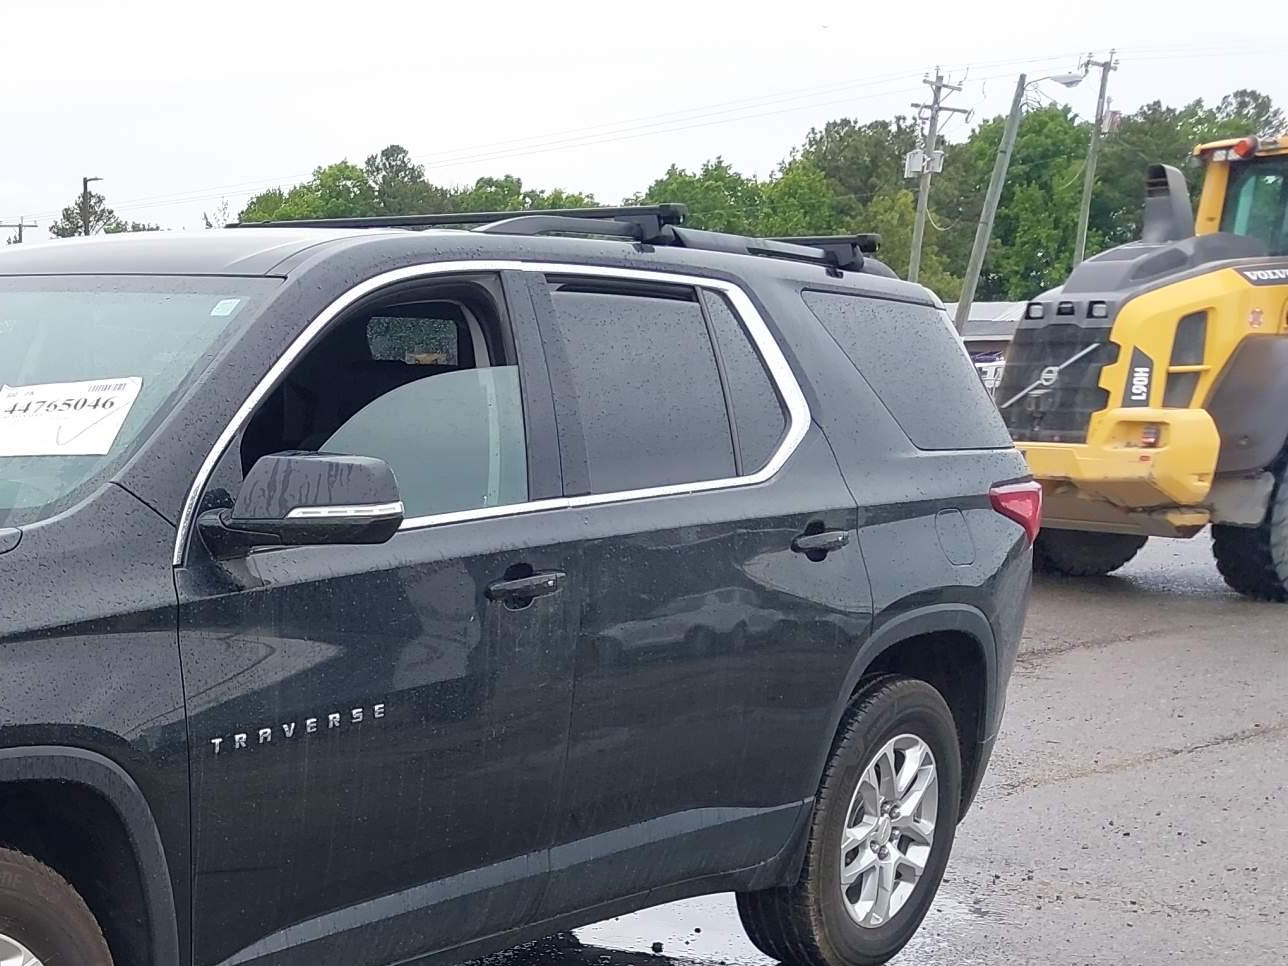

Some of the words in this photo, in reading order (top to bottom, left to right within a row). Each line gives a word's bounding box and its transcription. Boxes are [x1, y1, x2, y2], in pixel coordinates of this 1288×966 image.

[1243, 269, 1288, 280] VOLV
[1131, 367, 1149, 400] L90H
[4, 396, 115, 414] 44765046
[211, 704, 385, 754] TRAVERSE
